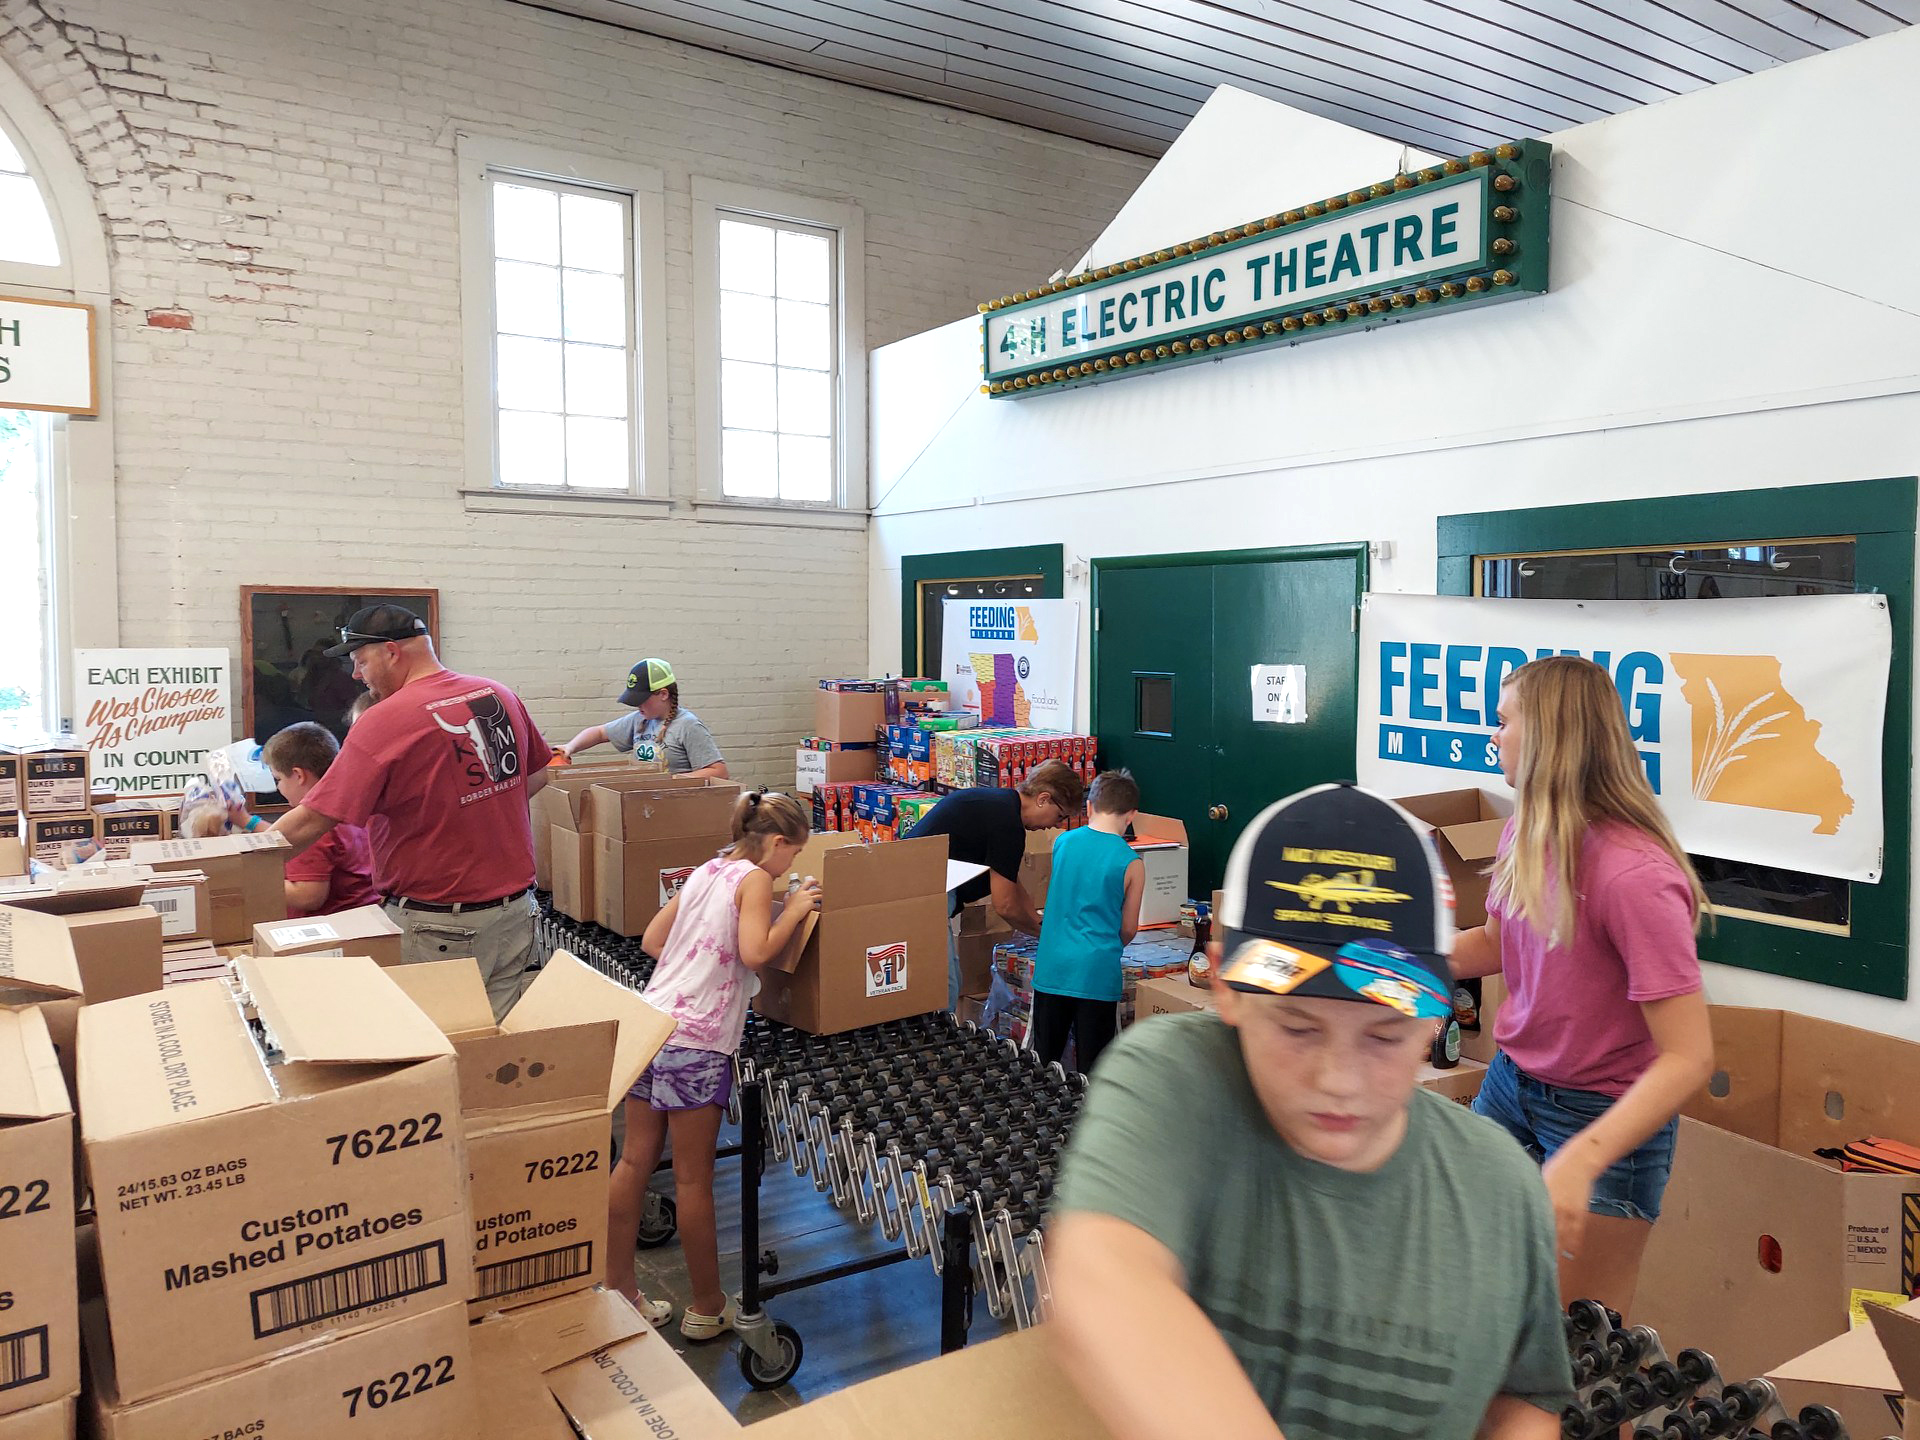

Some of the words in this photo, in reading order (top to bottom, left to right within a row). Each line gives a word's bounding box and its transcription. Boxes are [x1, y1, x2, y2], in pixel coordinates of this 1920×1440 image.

[1062, 268, 1226, 347] ELECTRIC
[1247, 202, 1459, 301] THEATRE
[970, 606, 1014, 628] FEEDING
[88, 668, 140, 685] EACH
[147, 666, 222, 685] EXHIBIT
[86, 696, 140, 727] Was
[141, 687, 219, 714] Chosen
[87, 722, 122, 750] As
[125, 705, 225, 741] Champion
[104, 753, 124, 768] IN
[134, 750, 209, 767] COUNT
[28, 780, 55, 788] DUKES
[36, 842, 62, 852] DUKES
[149, 1000, 174, 1026] STORE
[163, 1062, 190, 1081] DRY
[326, 1112, 443, 1165] 76222
[117, 1175, 178, 1198] 24/15.63
[181, 1168, 202, 1183] OZ
[205, 1157, 248, 1178] BAGS
[525, 1150, 599, 1183] 76222
[120, 1196, 150, 1212] NET
[153, 1189, 182, 1205] WT.
[185, 1180, 223, 1197] 23.45
[226, 1174, 246, 1187] LB
[241, 1200, 349, 1243] Custom
[476, 1209, 532, 1232] ustom
[495, 1217, 578, 1247] Potatoes
[1848, 1224, 1879, 1234] Produce
[1880, 1226, 1889, 1234] of
[163, 1239, 286, 1292] Mashed
[296, 1206, 424, 1257] Potatoes
[1857, 1245, 1887, 1255] MEXICO
[366, 1300, 396, 1315] 76222
[342, 1354, 456, 1418] 76222
[629, 1393, 648, 1404] A
[636, 1403, 657, 1417] IN
[223, 1419, 265, 1440] BAGS
